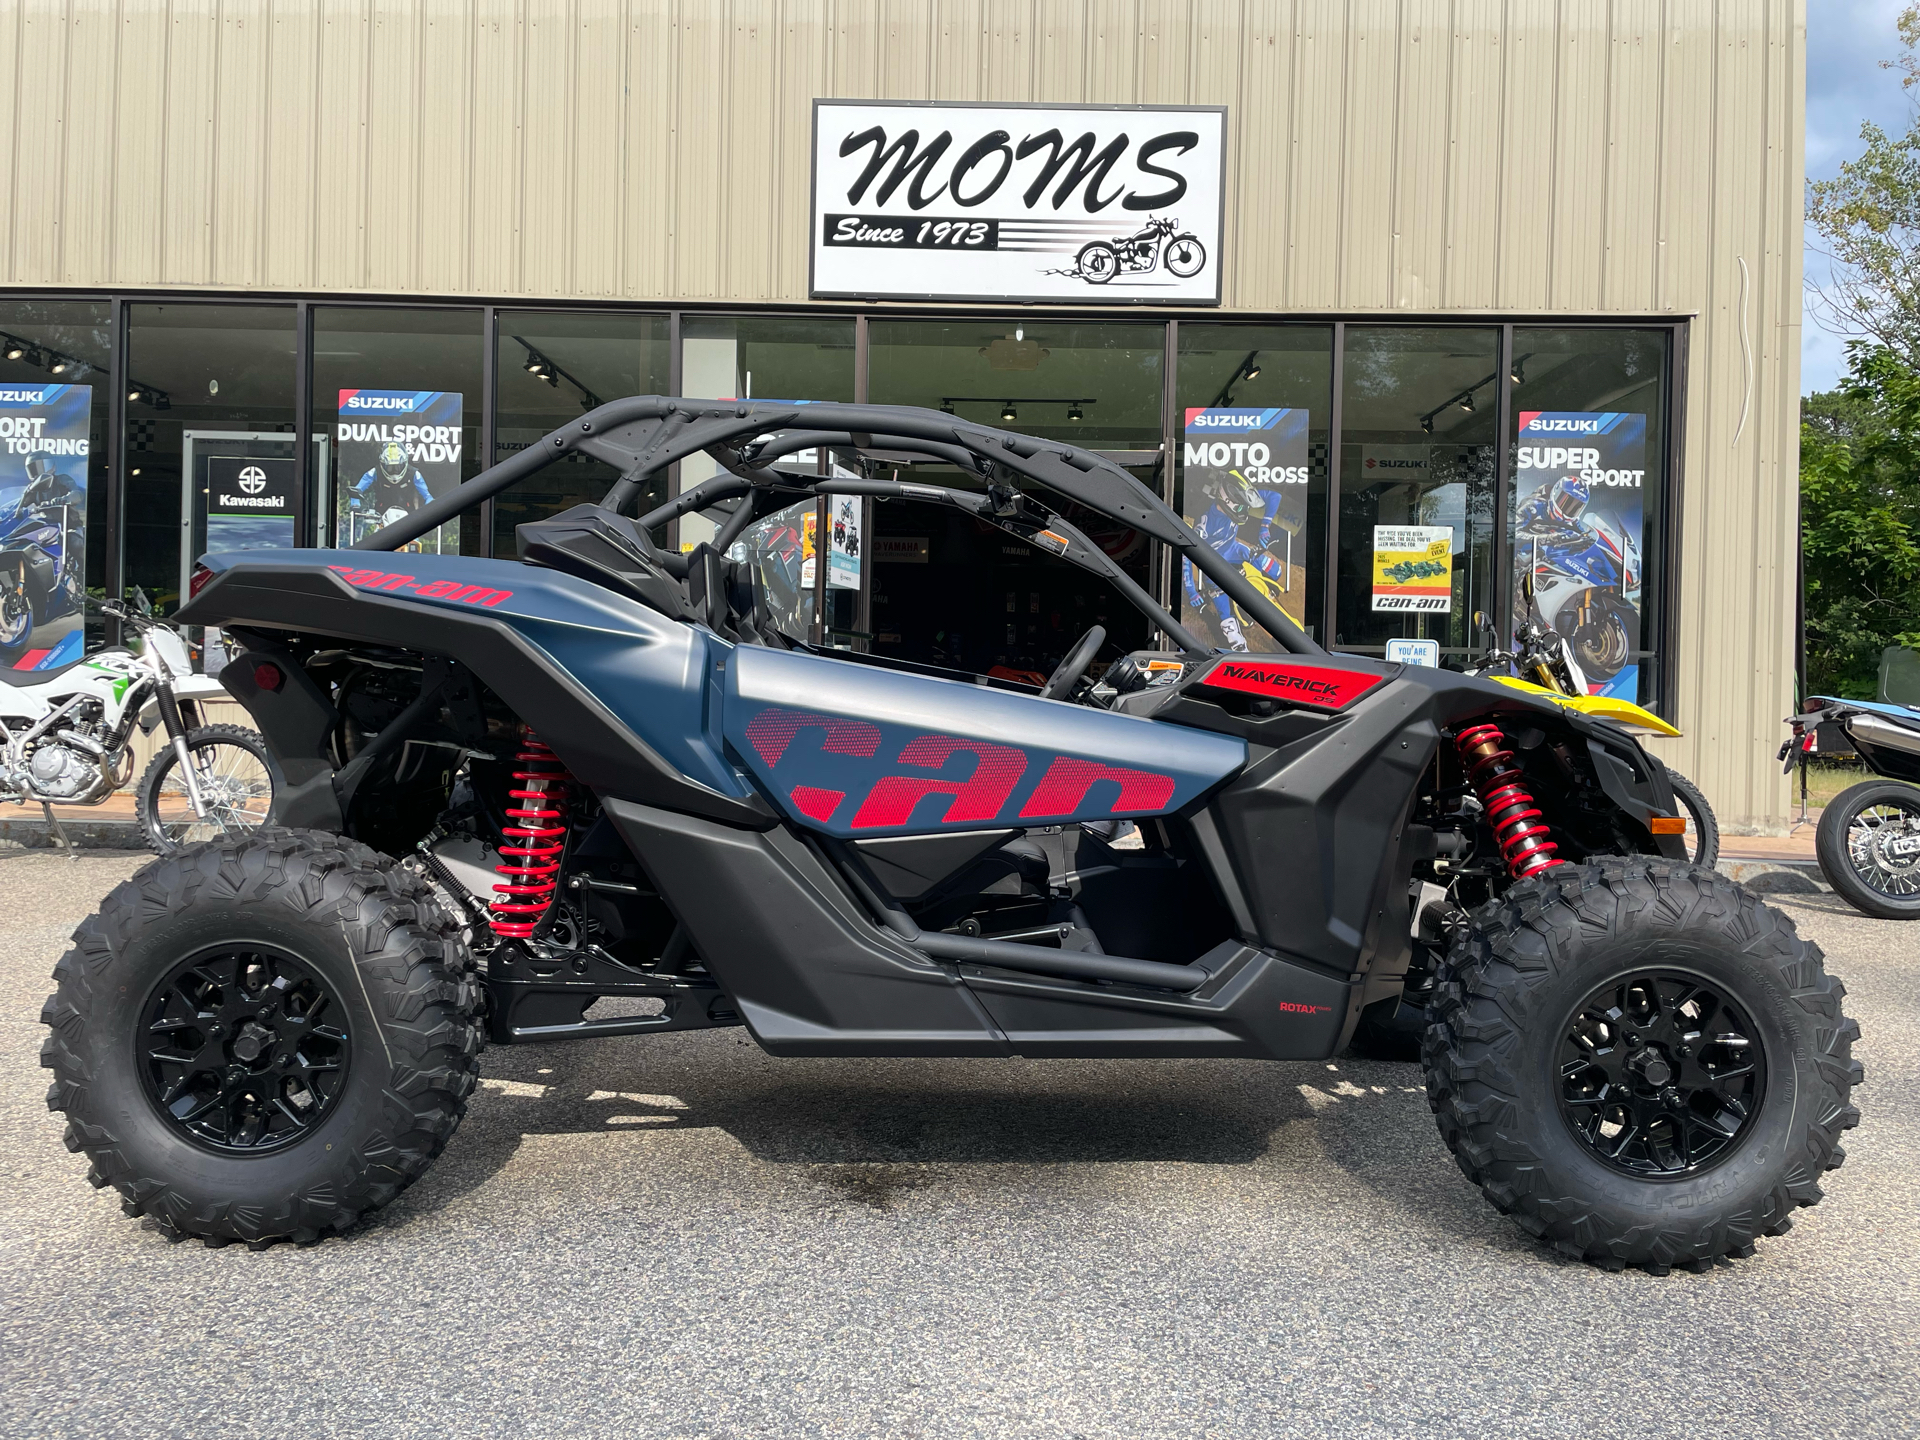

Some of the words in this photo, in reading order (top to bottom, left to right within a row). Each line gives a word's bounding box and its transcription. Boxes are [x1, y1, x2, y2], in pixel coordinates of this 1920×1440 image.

[839, 125, 1199, 213] MOMS
[832, 218, 904, 243] Since
[915, 221, 989, 245] 1973
[348, 397, 413, 409] SUZUKI
[1194, 415, 1260, 427] SUZUKI
[1528, 419, 1598, 431] SUZUKI
[6, 438, 89, 456] TOURING
[1184, 442, 1270, 467] MOTO
[1379, 460, 1427, 468] SUZUKI
[1517, 446, 1600, 469] SUPER
[1243, 466, 1309, 484] CROSS
[1579, 469, 1645, 487] SPORT
[219, 494, 285, 508] Kawasaki
[882, 541, 919, 552] YAMAHA
[1002, 546, 1030, 556] YAMAHA
[1564, 558, 1590, 577] SUZUKI
[1376, 597, 1447, 609] can-am
[1398, 647, 1412, 656] YOU
[1413, 647, 1427, 656] ARE
[1222, 665, 1341, 695] MAVERICK
[745, 708, 1175, 829] can
[1280, 1002, 1317, 1014] ROTAX
